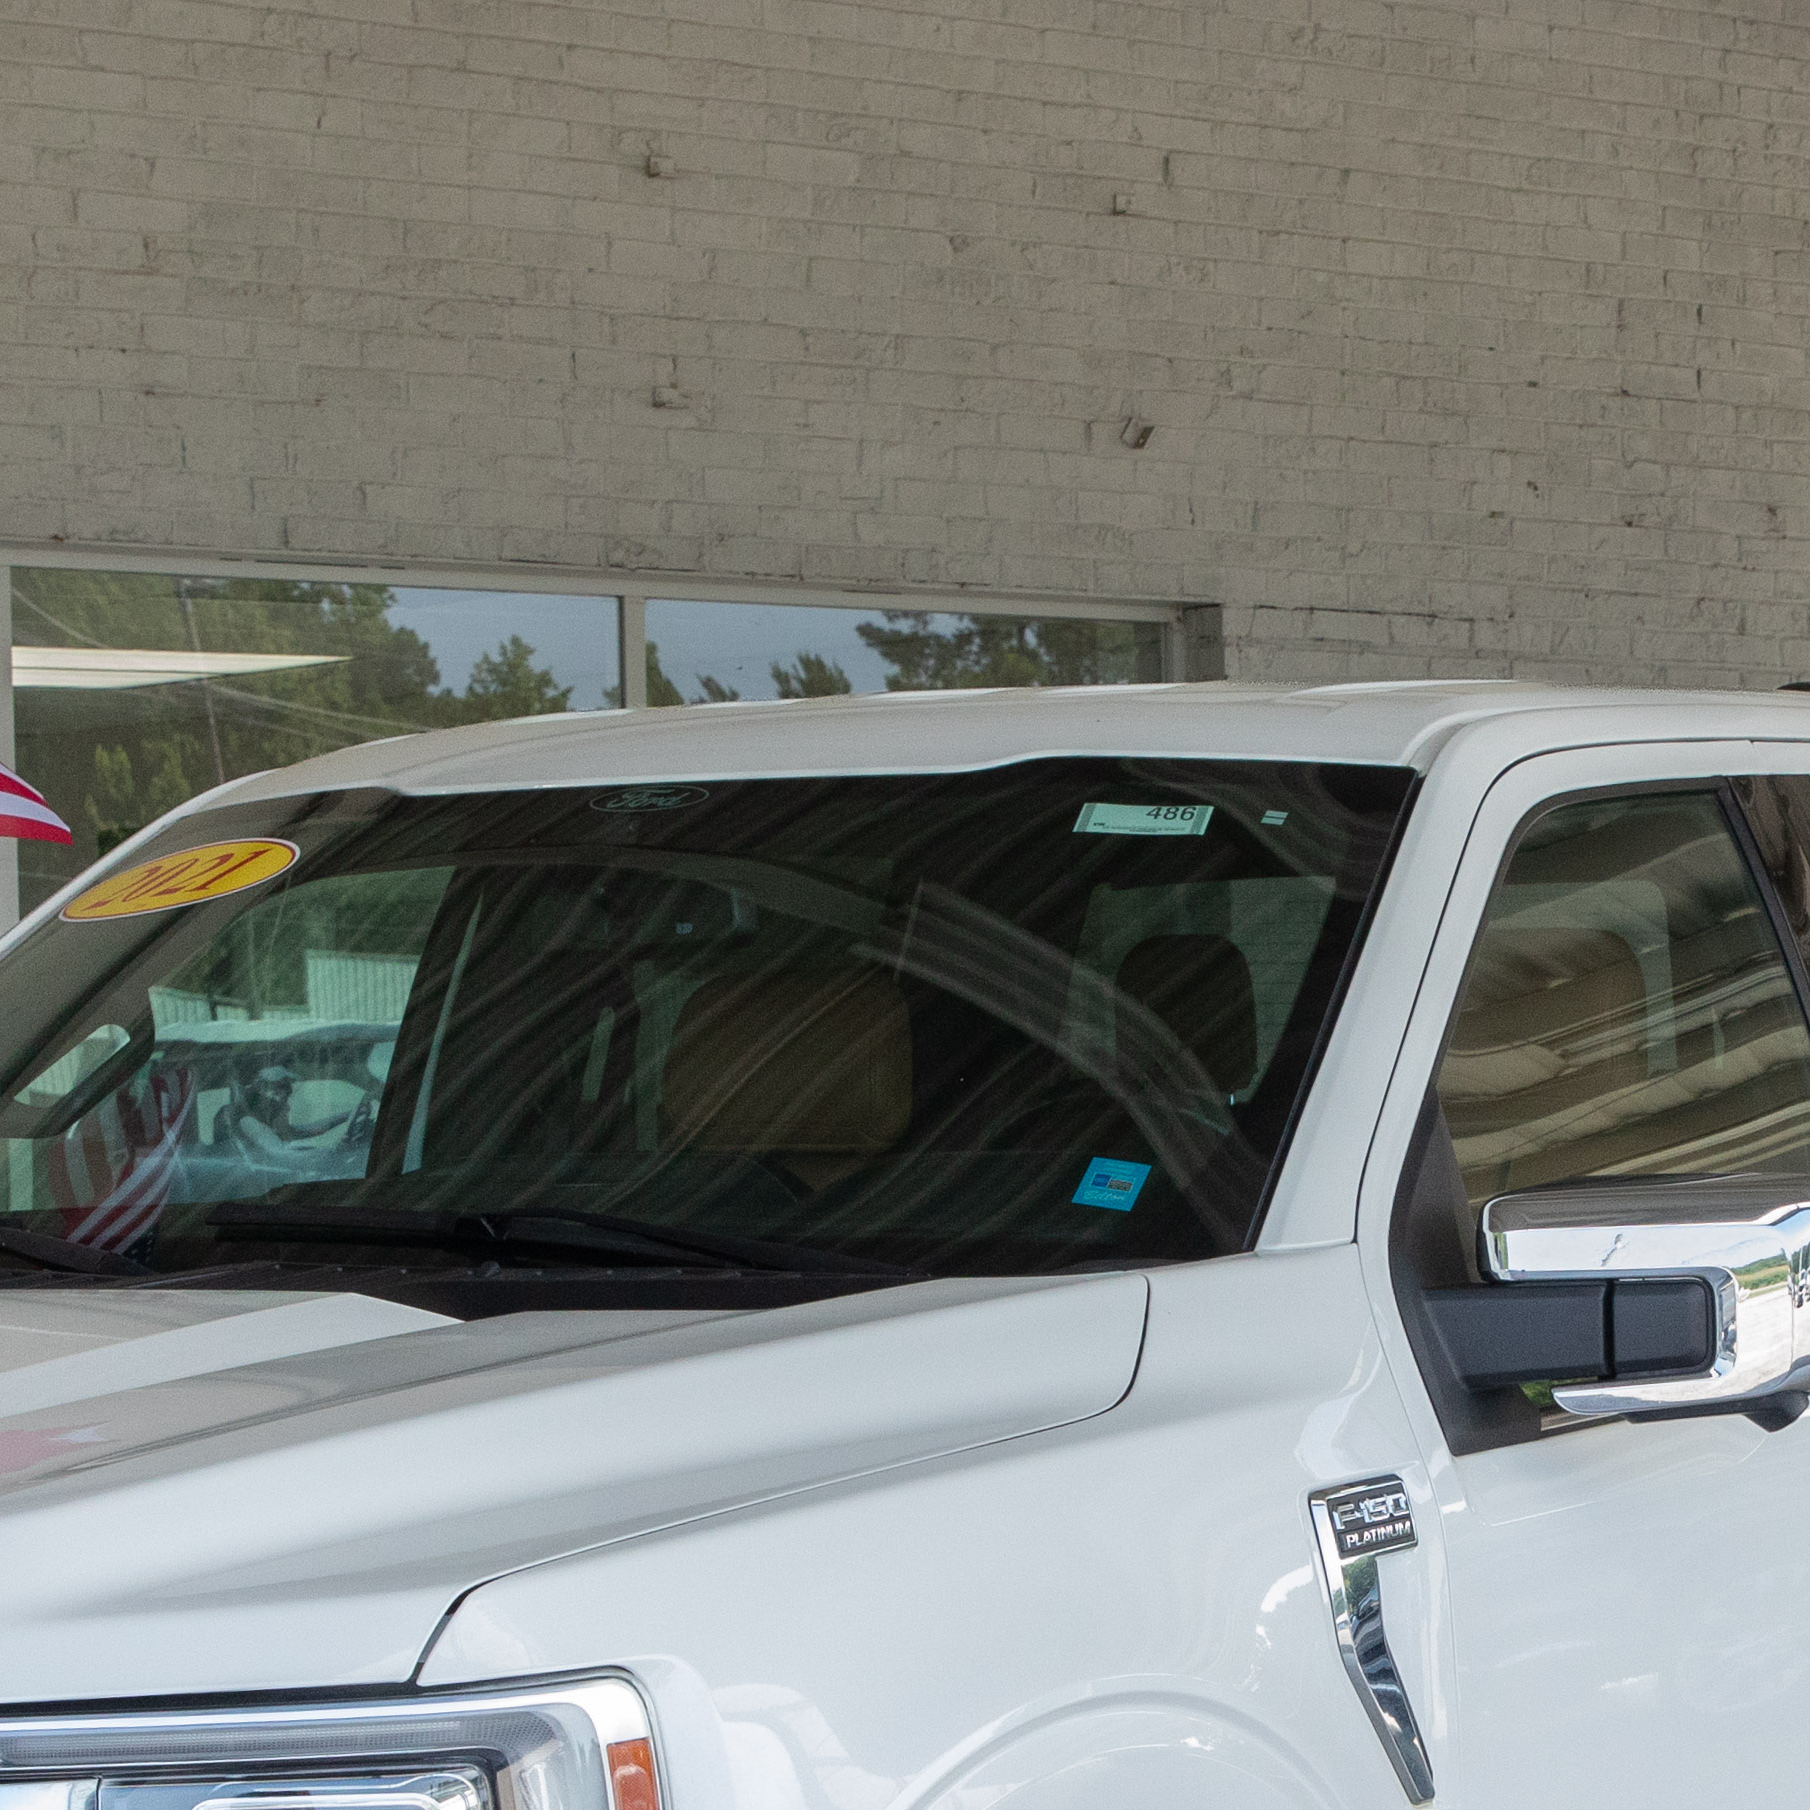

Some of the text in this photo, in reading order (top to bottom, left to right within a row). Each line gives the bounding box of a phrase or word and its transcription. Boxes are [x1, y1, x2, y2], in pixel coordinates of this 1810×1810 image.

[606, 788, 691, 809] Ford
[1145, 805, 1197, 821] 486
[81, 848, 273, 912] 2021
[1332, 1492, 1410, 1530] F-150
[1345, 1520, 1411, 1549] PLATINUM
